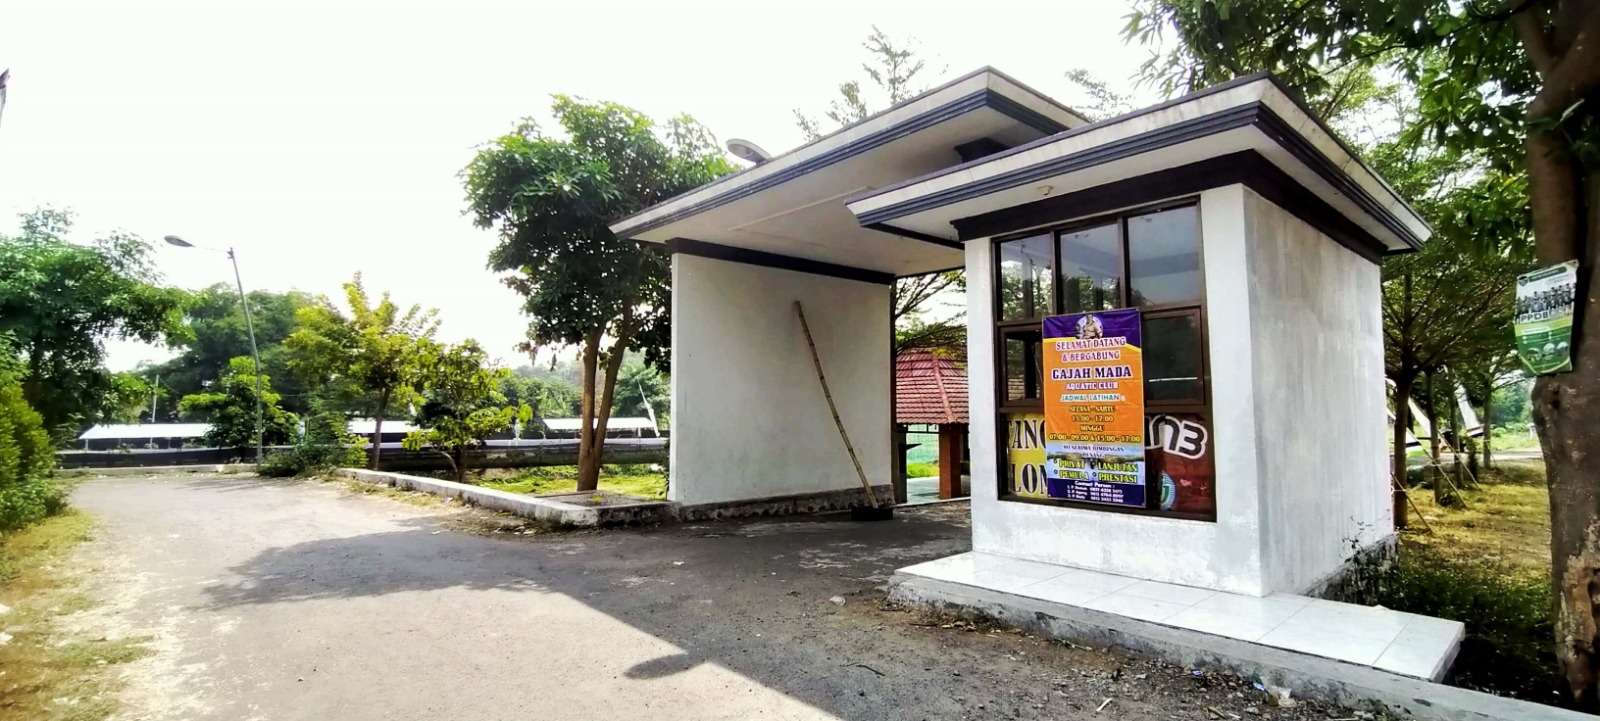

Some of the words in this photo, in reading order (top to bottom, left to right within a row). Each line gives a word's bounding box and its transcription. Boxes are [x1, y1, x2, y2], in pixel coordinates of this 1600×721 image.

[1520, 311, 1549, 323] PPDB
[1056, 340, 1091, 351] SELAMAT
[1093, 337, 1126, 348] DATANG
[1062, 353, 1069, 362] &
[1070, 351, 1120, 361] BERGABUNG
[1052, 368, 1091, 380] GAJAH
[1094, 366, 1132, 378] MADA
[1059, 460, 1085, 469] PRIVAT
[1098, 462, 1138, 472] LANJUTAN
[1060, 470, 1089, 480] PEMULA
[1098, 472, 1137, 483] PRESTASI
